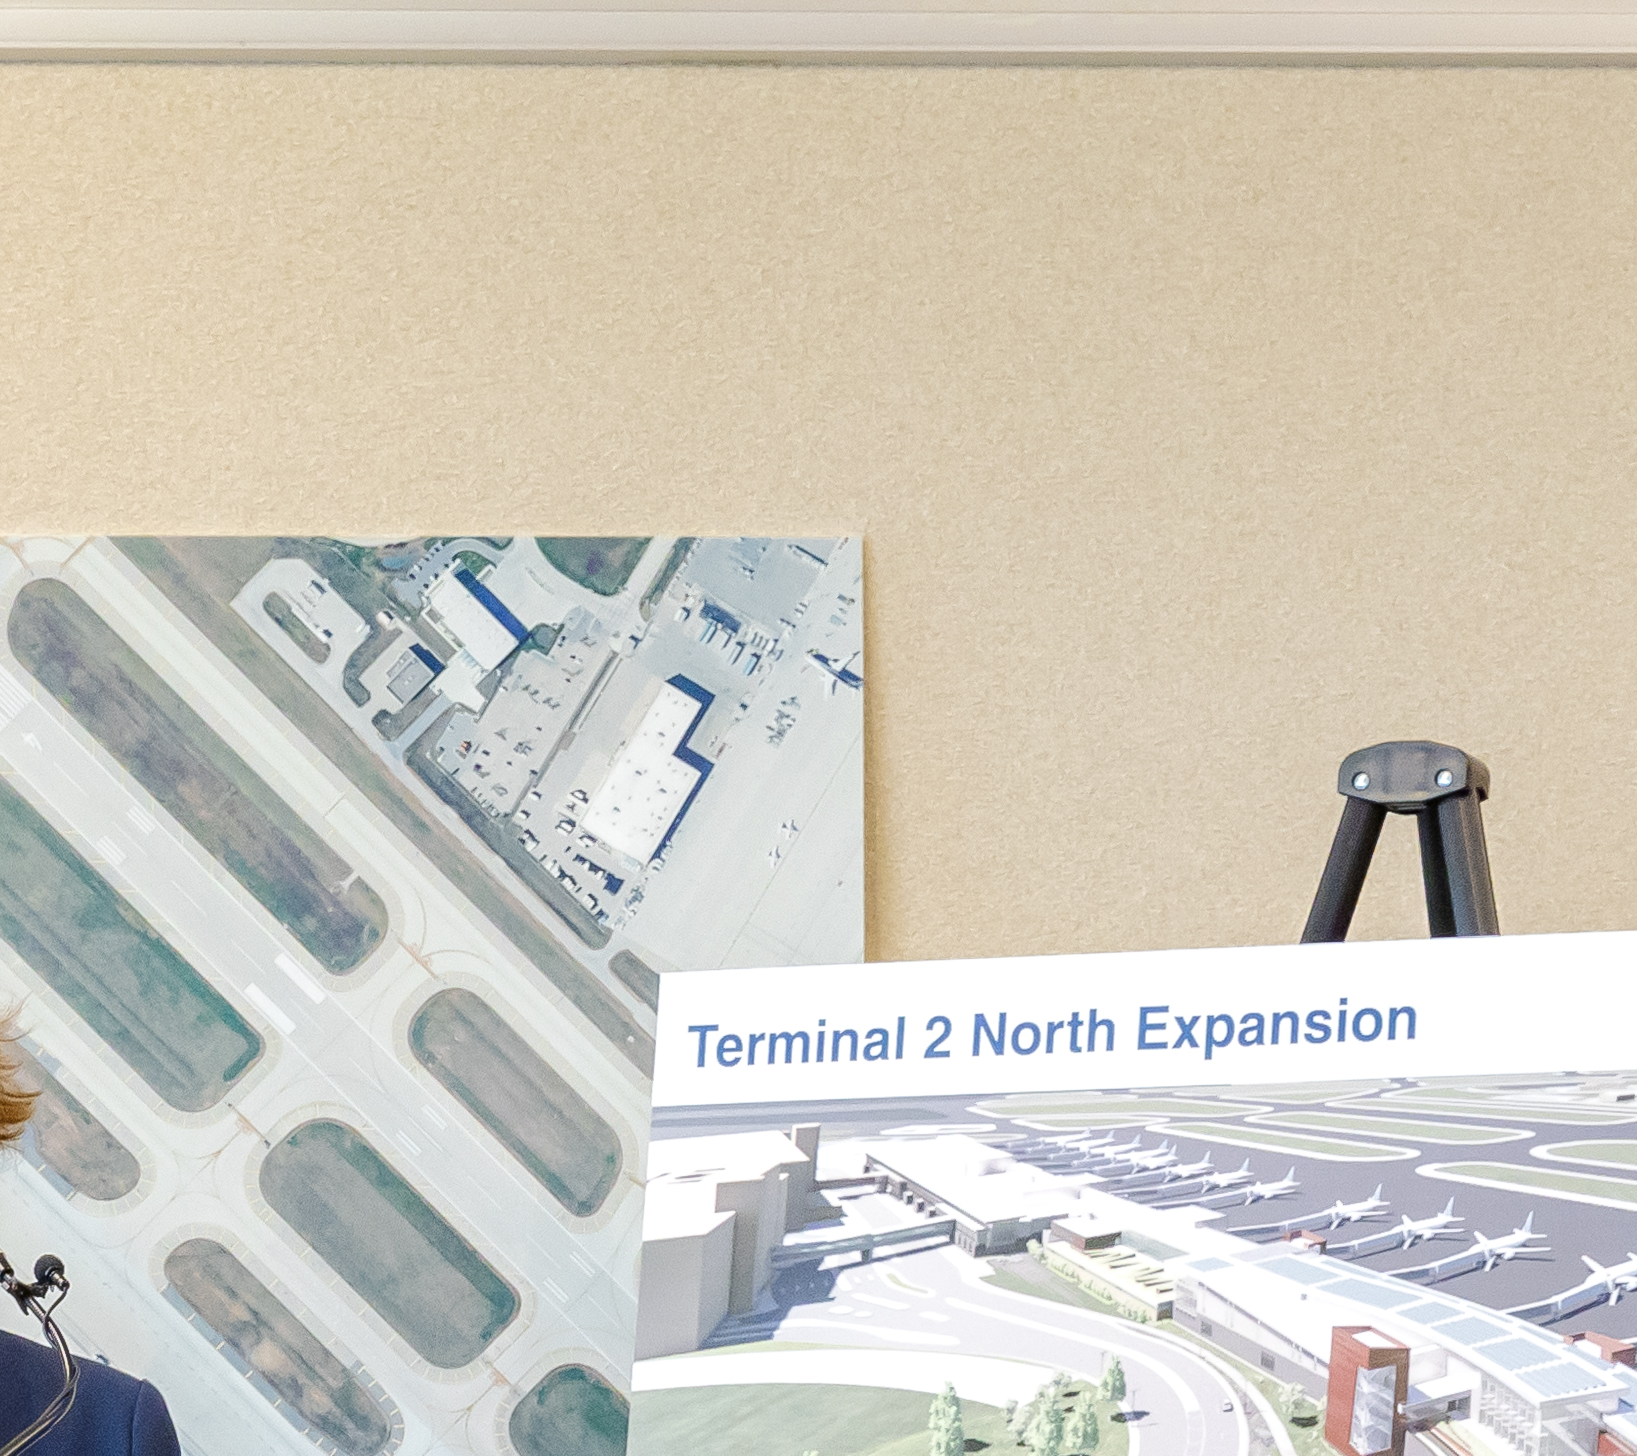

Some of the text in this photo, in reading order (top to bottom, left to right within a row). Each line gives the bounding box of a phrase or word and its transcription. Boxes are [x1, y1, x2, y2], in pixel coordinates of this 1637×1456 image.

[687, 997, 1417, 1068] Terminal 2 North Expansion
